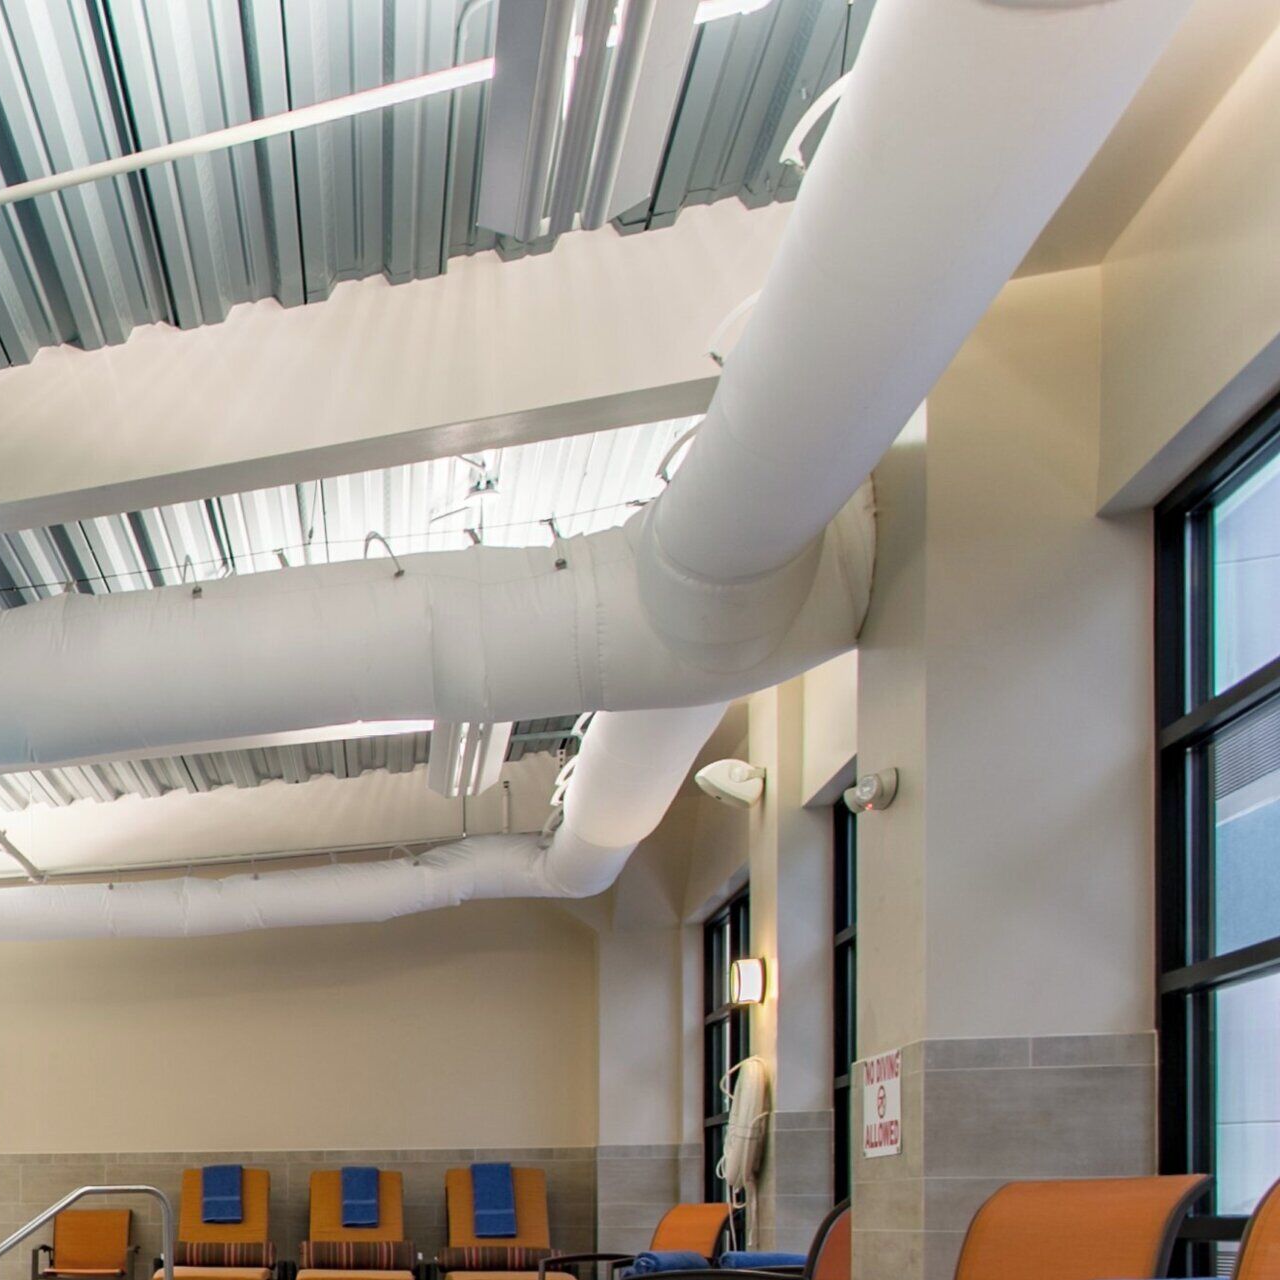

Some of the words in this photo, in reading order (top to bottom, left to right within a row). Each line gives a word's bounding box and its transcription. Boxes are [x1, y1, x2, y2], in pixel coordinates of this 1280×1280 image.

[864, 1060, 874, 1085] NO
[876, 1051, 900, 1082] DIVING
[865, 1119, 899, 1149] ALLOWED
